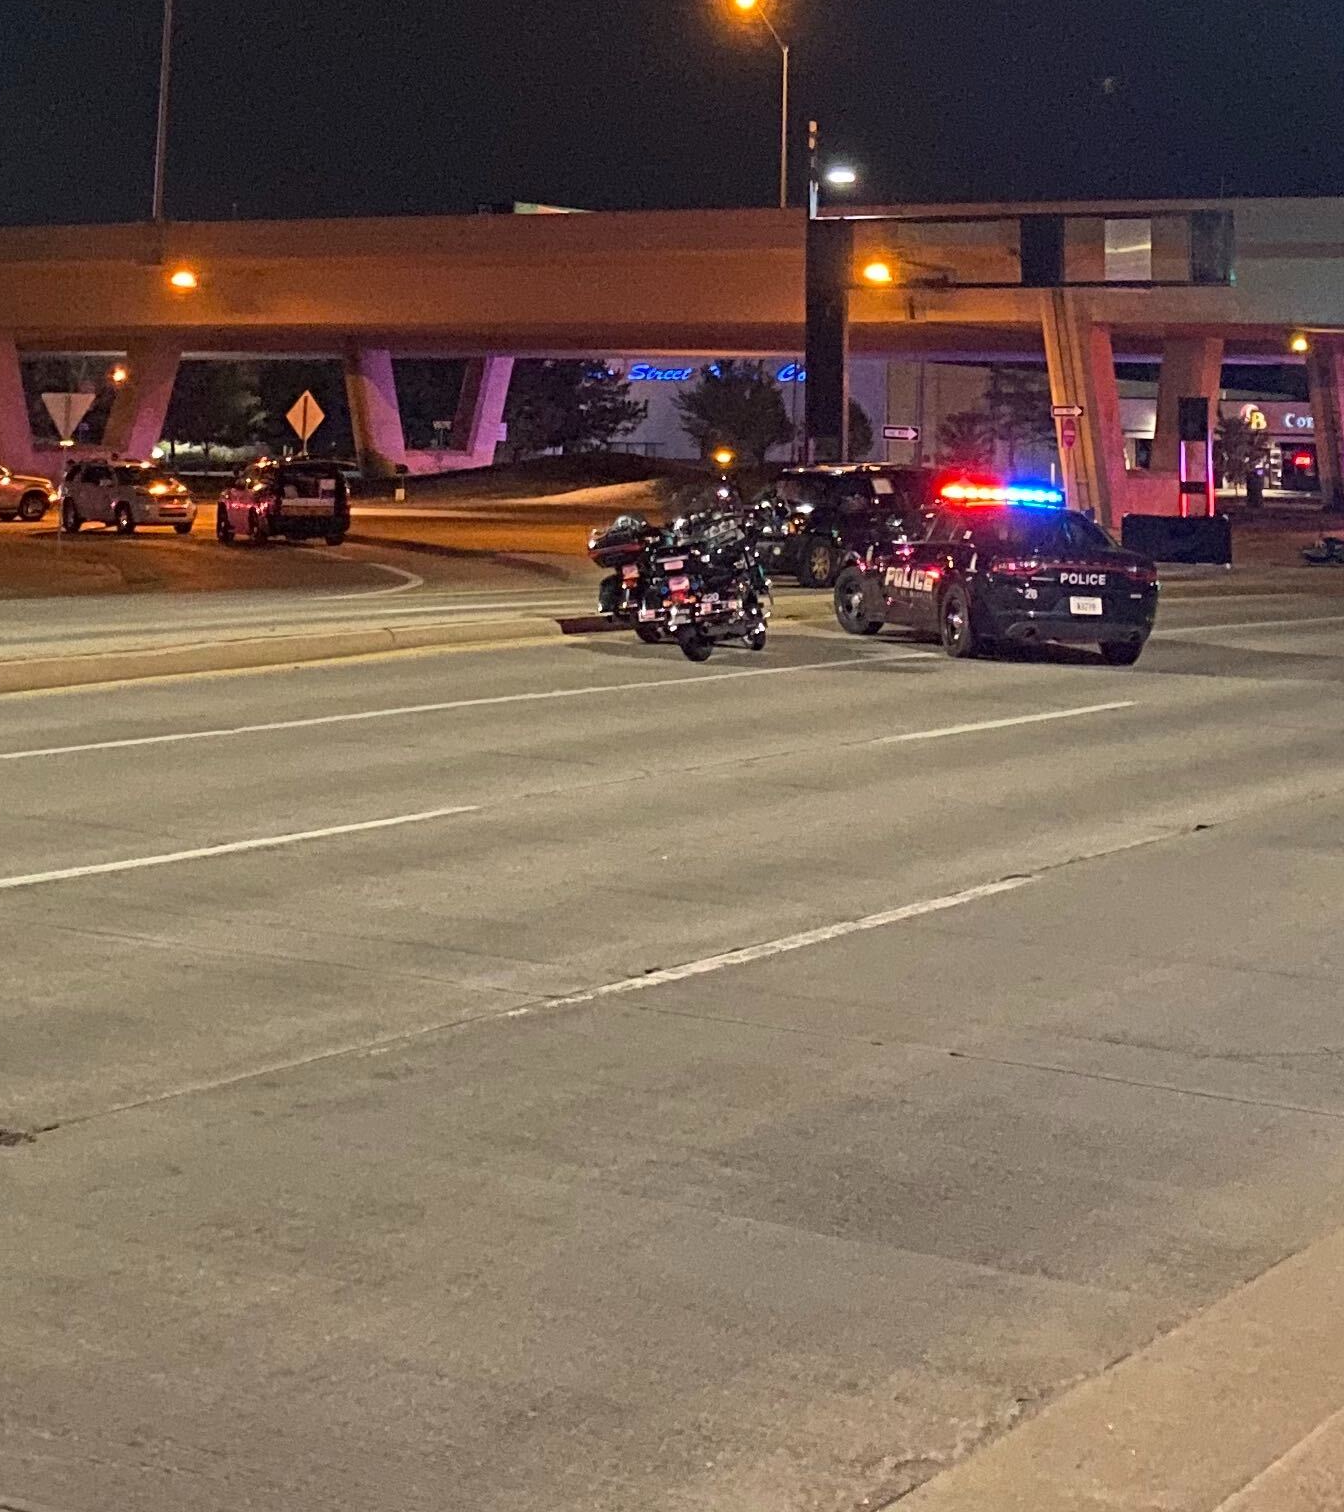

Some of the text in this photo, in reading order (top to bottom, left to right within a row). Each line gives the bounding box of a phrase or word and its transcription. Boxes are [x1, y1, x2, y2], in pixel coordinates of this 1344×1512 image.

[627, 362, 692, 381] Street
[884, 566, 935, 593] POLICE
[1059, 572, 1107, 586] POLICE
